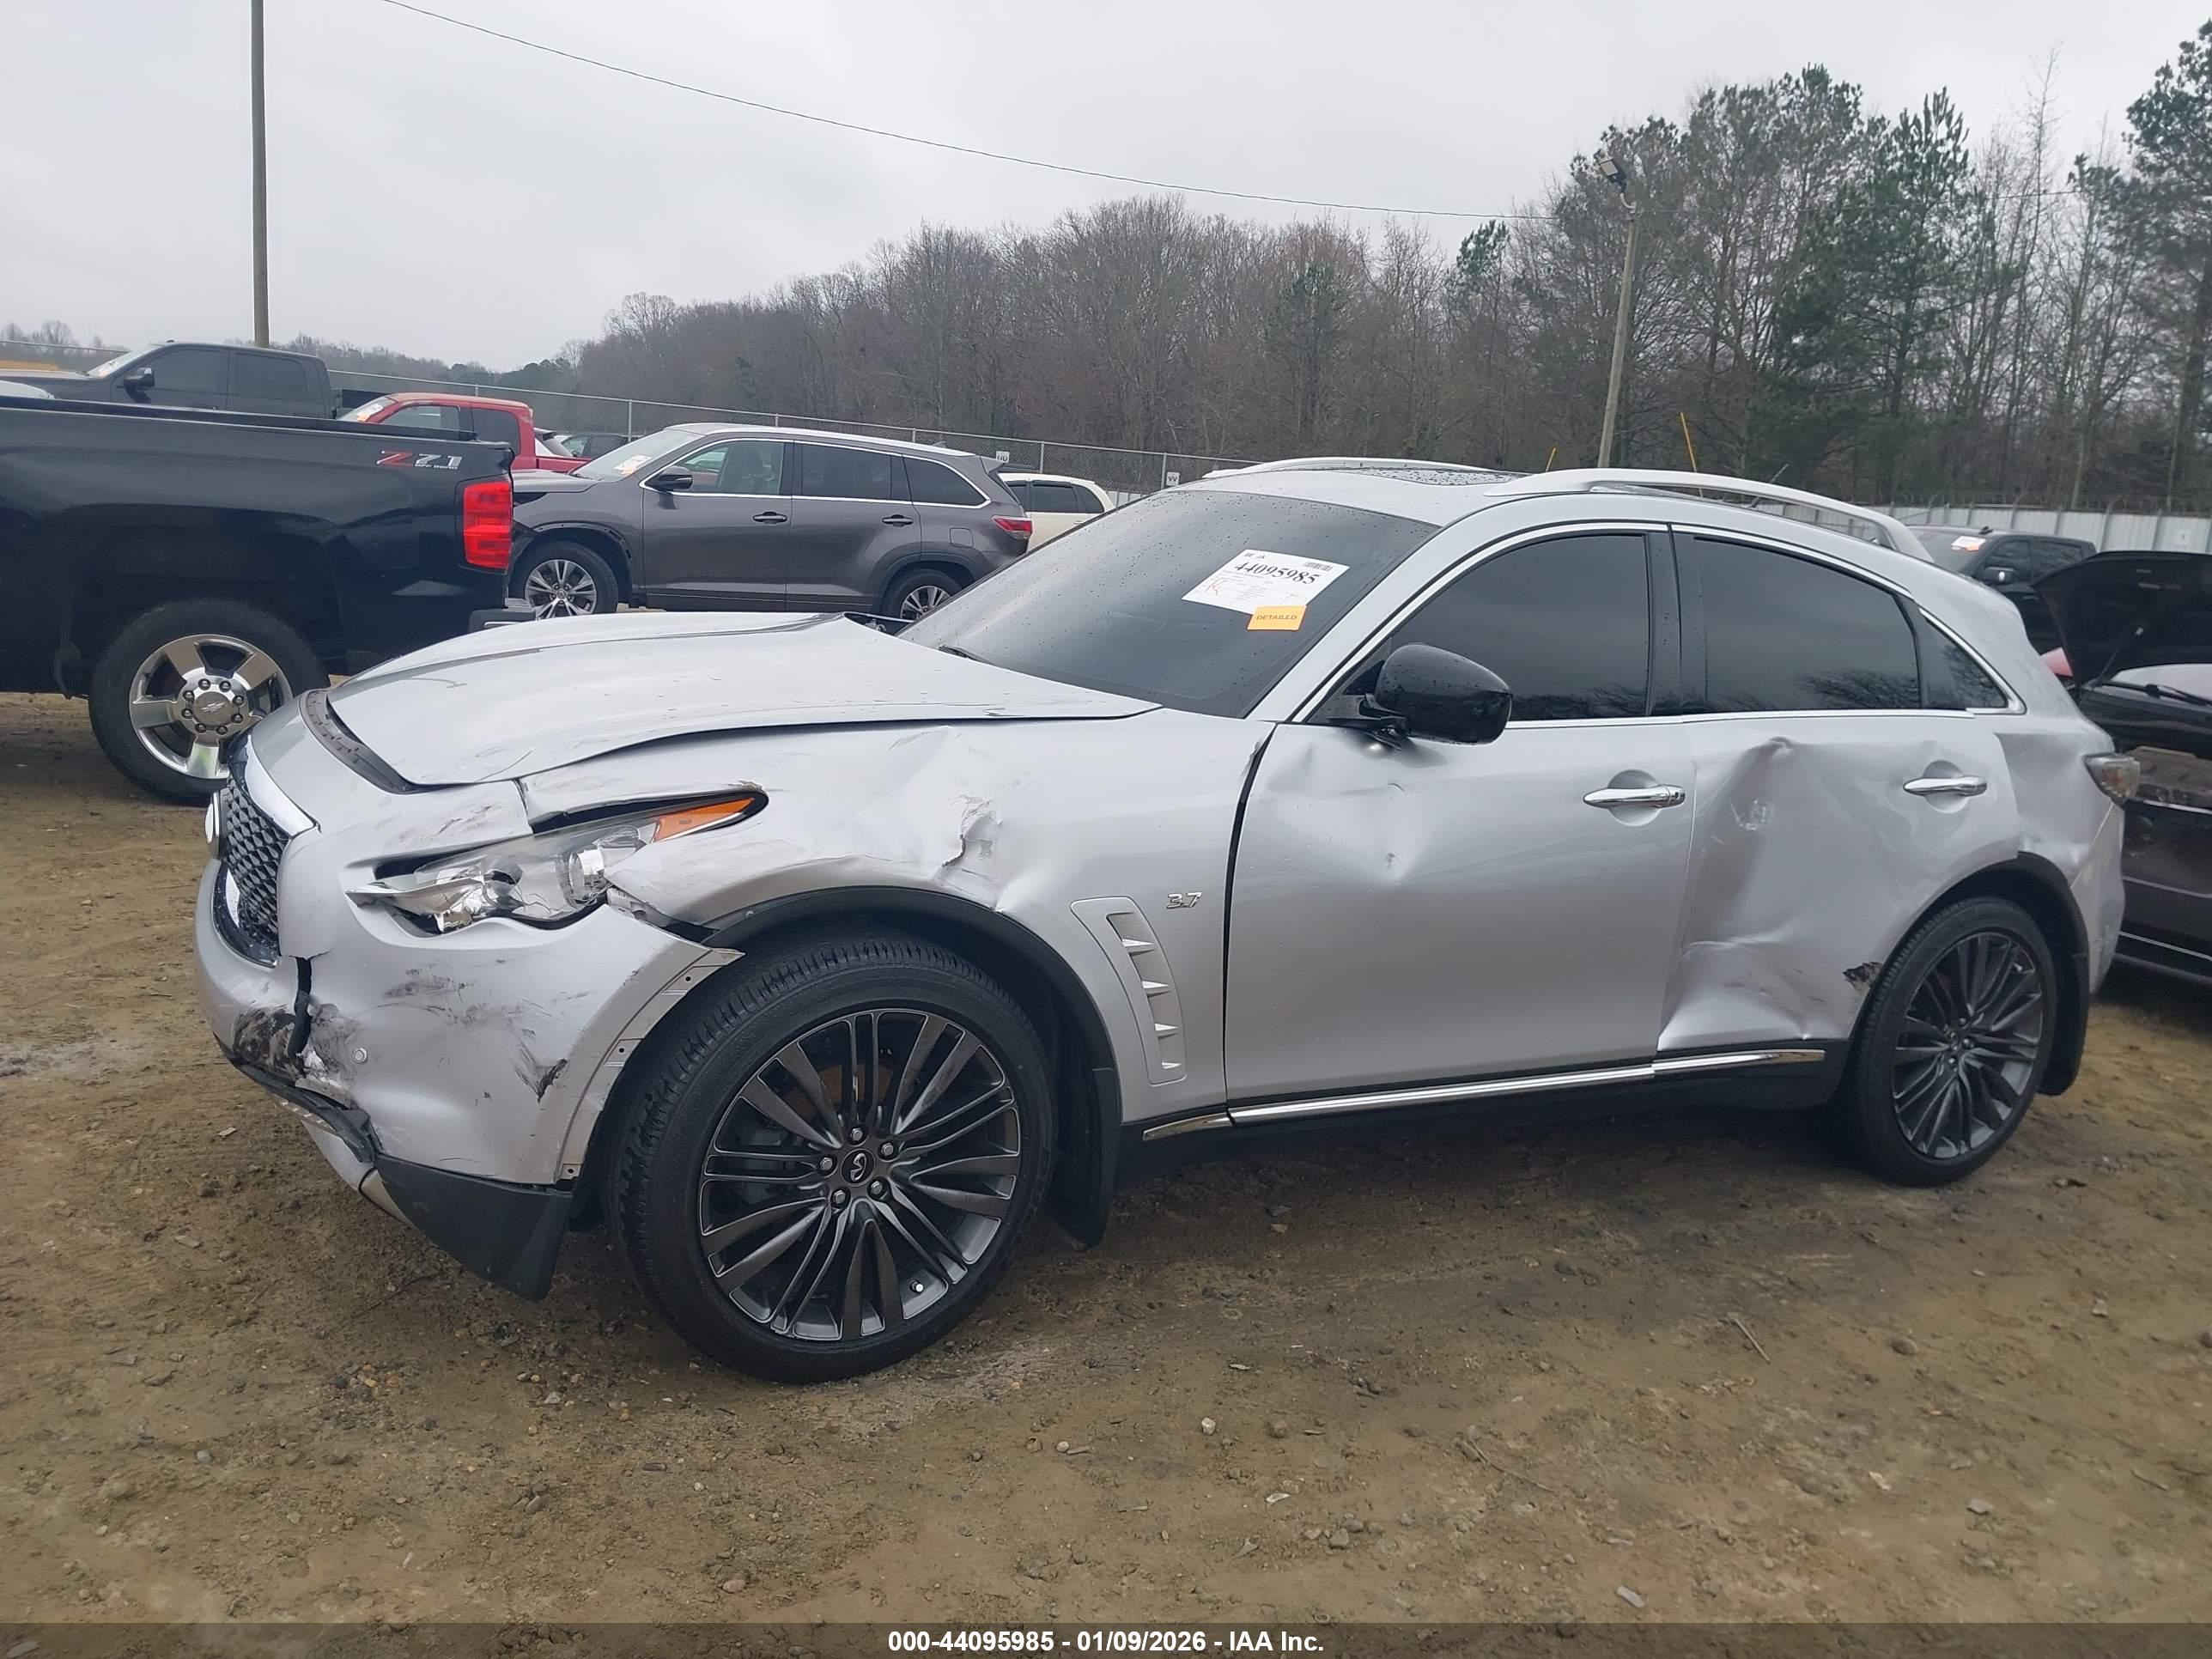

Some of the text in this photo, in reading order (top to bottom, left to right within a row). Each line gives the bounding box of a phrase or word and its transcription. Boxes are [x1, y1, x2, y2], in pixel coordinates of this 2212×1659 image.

[376, 450, 463, 467] Z71
[1234, 562, 1321, 584] 44095985
[1166, 891, 1202, 909] 3.7
